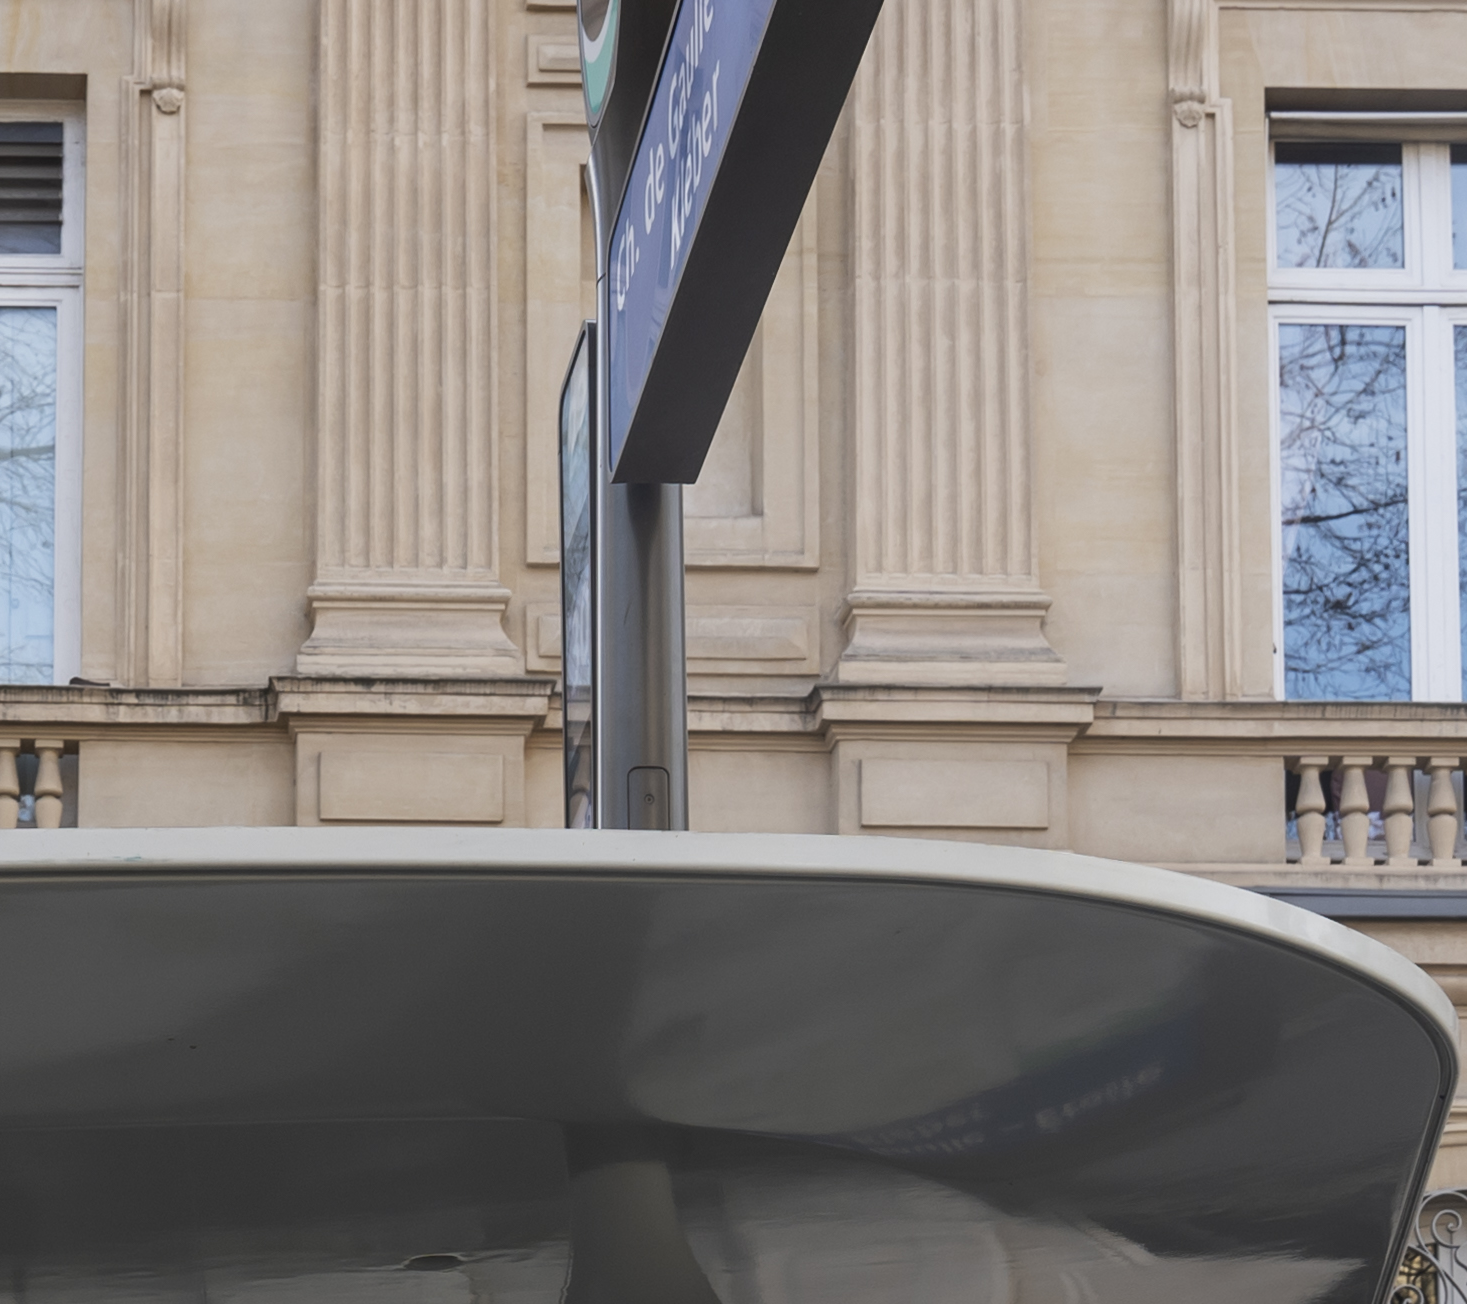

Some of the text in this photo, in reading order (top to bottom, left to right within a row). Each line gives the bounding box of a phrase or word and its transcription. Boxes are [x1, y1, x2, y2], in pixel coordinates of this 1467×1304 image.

[617, 217, 639, 311] Ch.
[644, 143, 664, 235] de
[670, 59, 719, 270] Kléber
